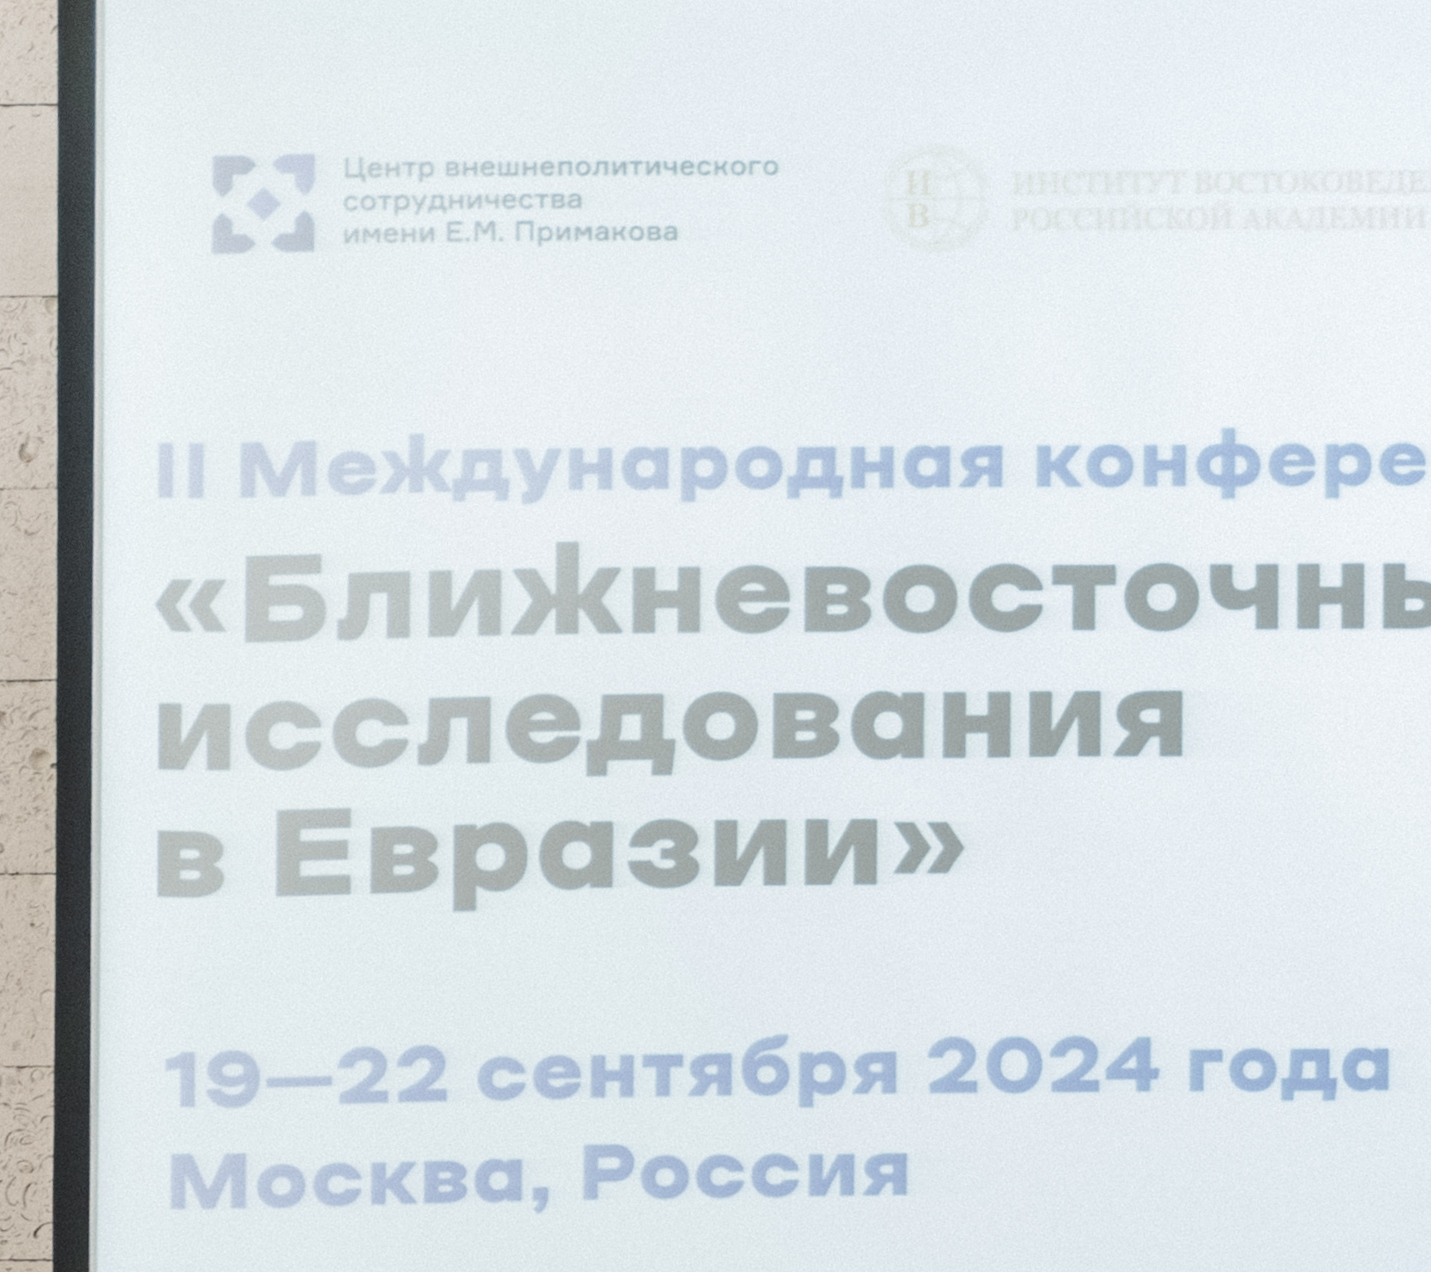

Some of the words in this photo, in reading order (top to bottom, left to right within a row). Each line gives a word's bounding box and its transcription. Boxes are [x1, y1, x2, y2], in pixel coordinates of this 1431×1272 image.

[342, 155, 436, 181] Центр
[443, 156, 782, 179] внешнеполитического
[1010, 168, 1188, 197] ИНСТИТУТ
[341, 190, 585, 216] сотрудничества
[1010, 199, 1234, 233] РОССИЙСКОЙ
[1240, 204, 1429, 233] АКАДЕМИИ
[341, 224, 438, 246] имени
[444, 219, 506, 244] Е.М.
[513, 218, 681, 247] Примакова
[238, 433, 1007, 504] Международная
[155, 687, 1187, 778] исследования
[155, 828, 228, 900] в
[274, 807, 968, 914] Евразии»
[476, 1033, 901, 1109] сентября
[926, 1034, 1162, 1096] 2024
[1187, 1045, 1393, 1102] года
[169, 1152, 553, 1215] Москва,
[581, 1143, 911, 1202] Россия
